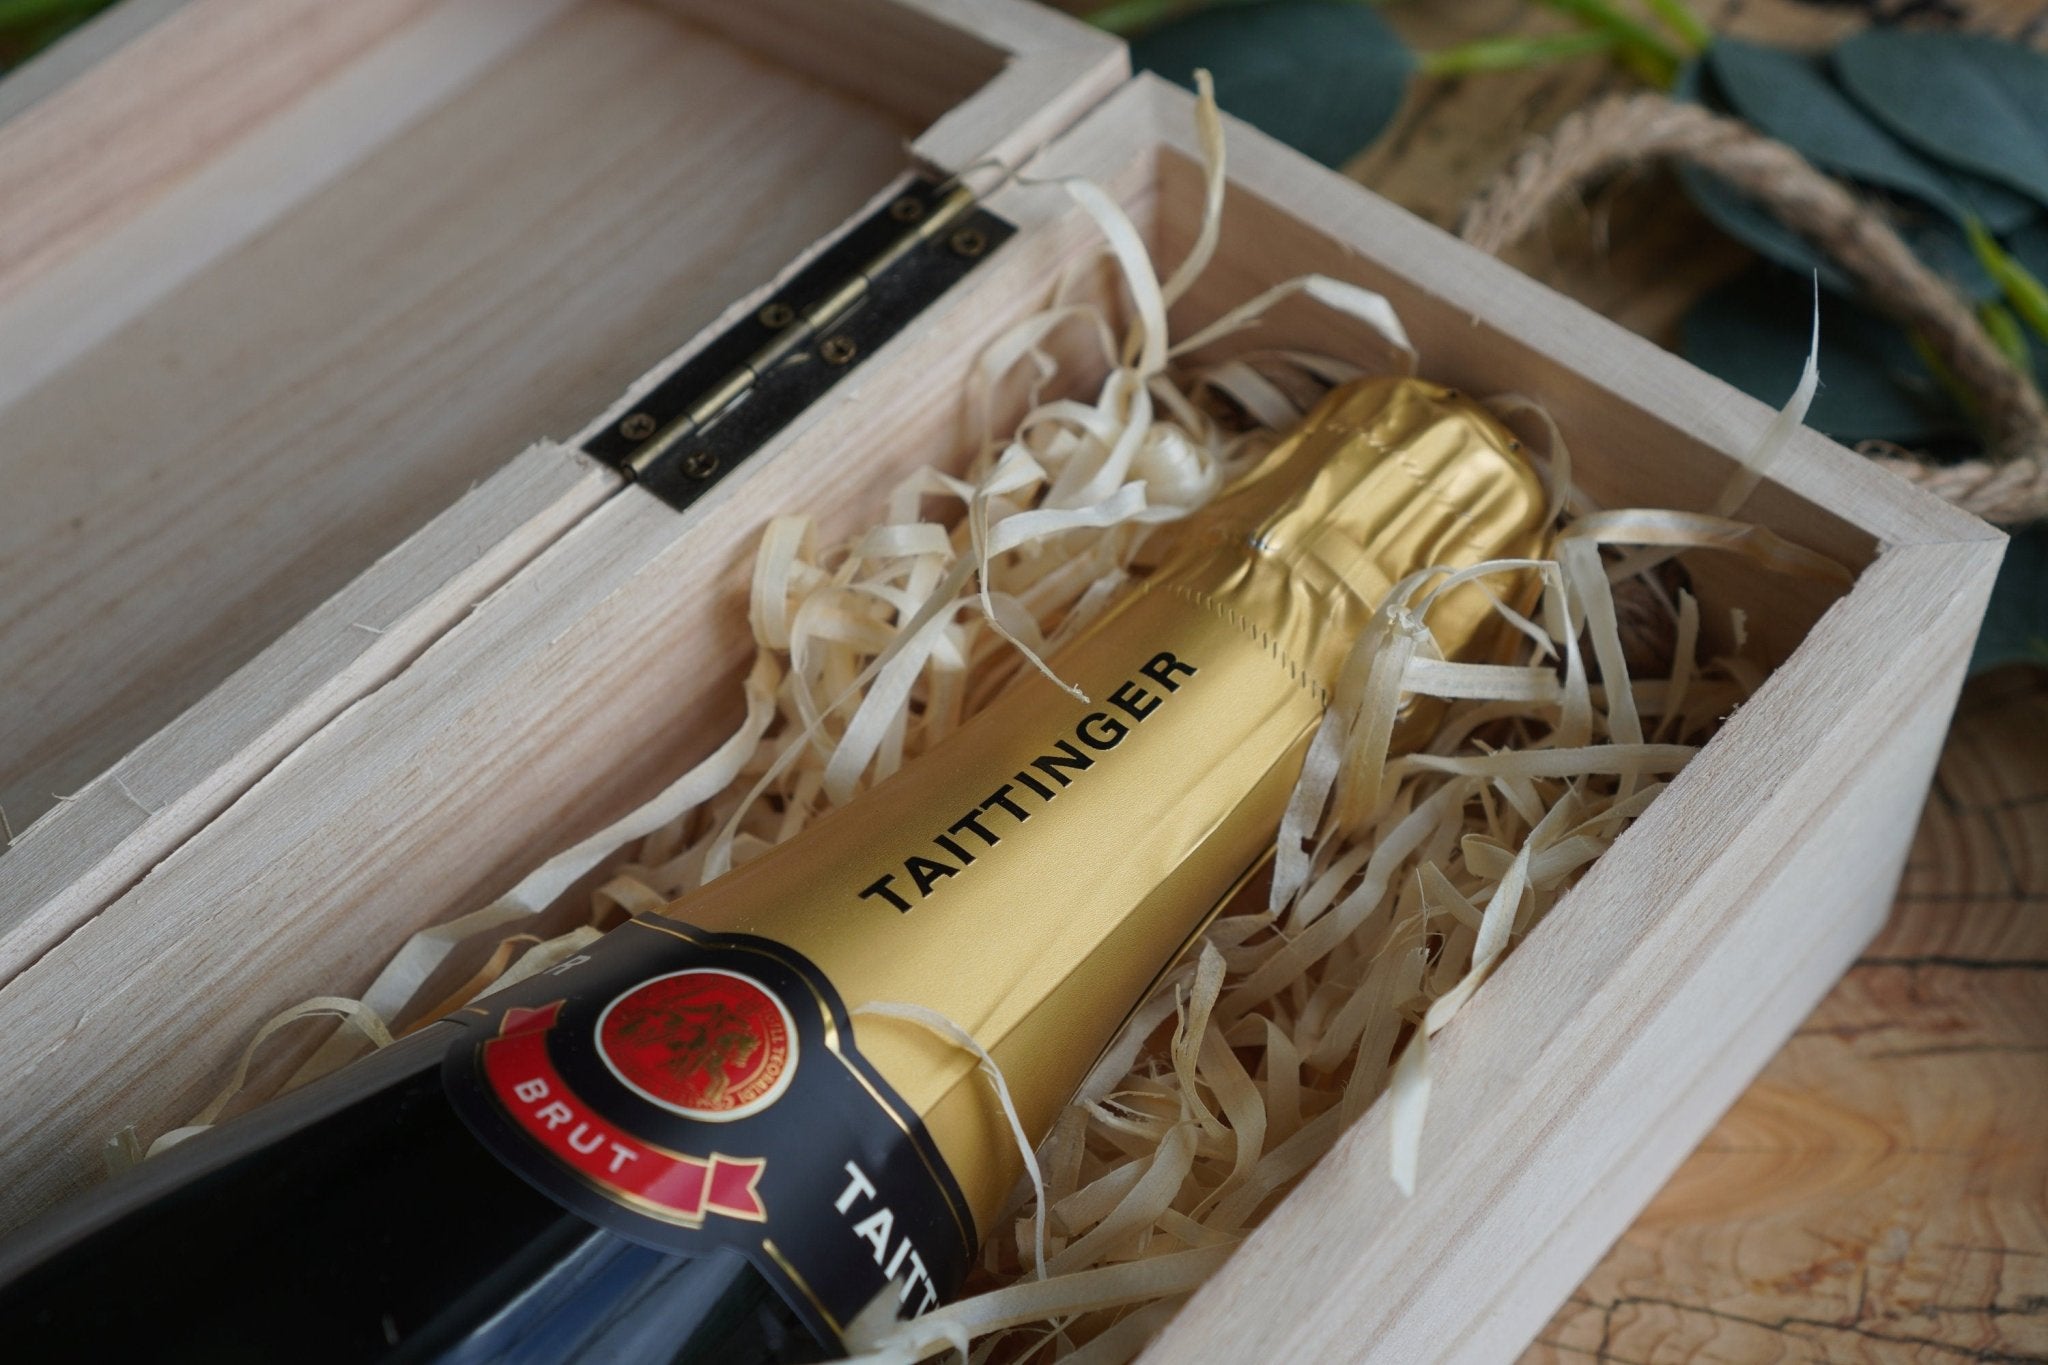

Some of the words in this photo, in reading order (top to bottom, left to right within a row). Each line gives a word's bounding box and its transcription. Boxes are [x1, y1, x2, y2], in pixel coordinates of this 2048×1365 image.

[858, 651, 1199, 914] TAITTINGER
[513, 1077, 639, 1173] BRUT
[834, 1159, 940, 1319] TAITT
